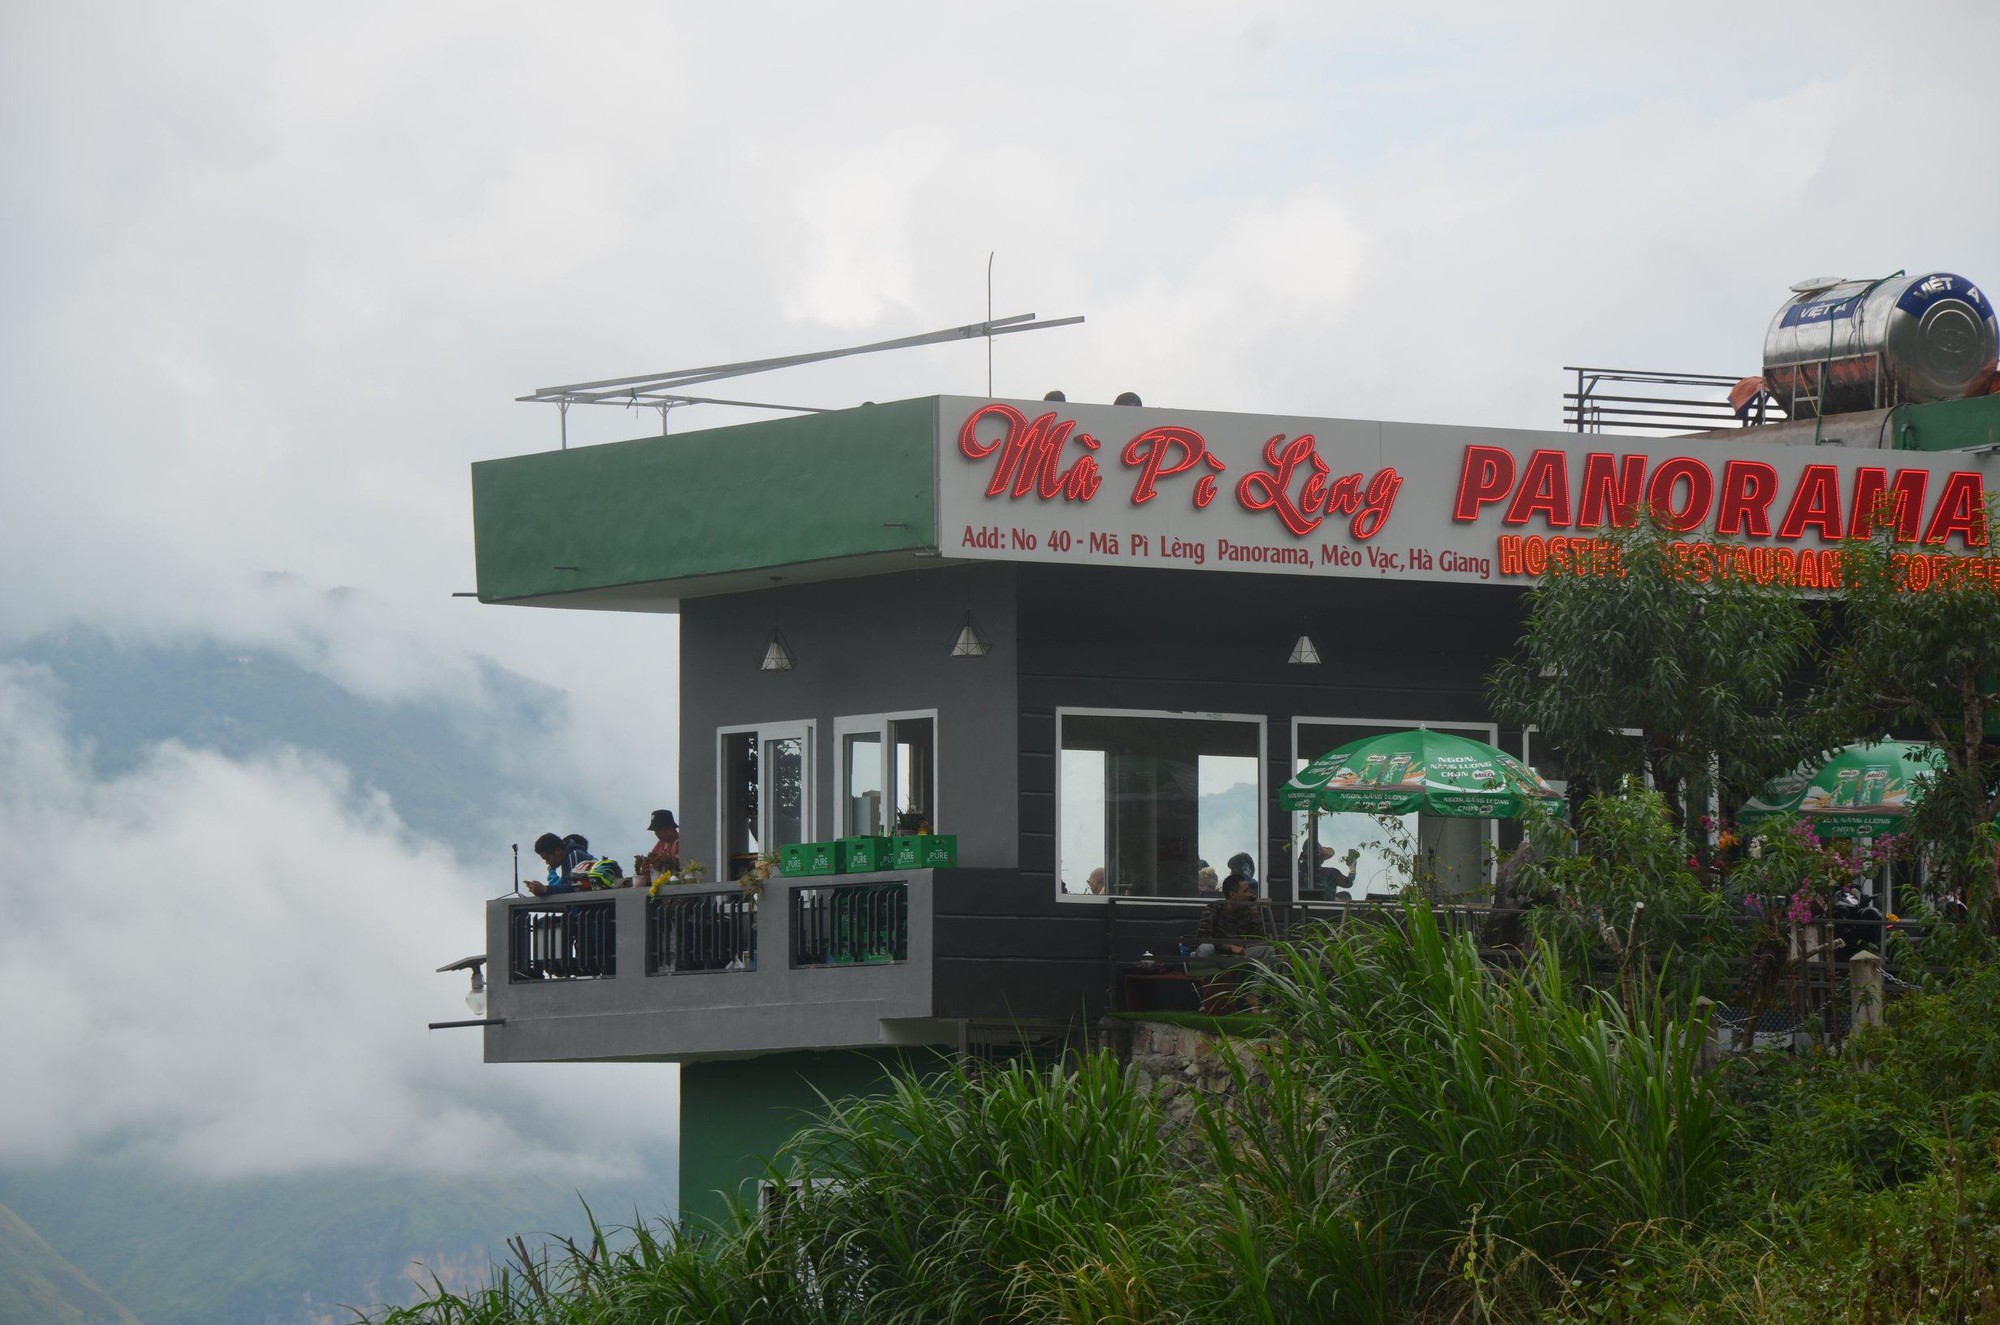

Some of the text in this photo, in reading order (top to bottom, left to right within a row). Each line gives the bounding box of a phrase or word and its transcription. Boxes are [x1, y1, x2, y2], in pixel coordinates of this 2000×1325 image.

[1121, 426, 1225, 509] Pì
[1235, 434, 1403, 541] Lèng
[1452, 444, 1989, 547] PANORAMA
[962, 525, 1006, 549] Add:
[1012, 527, 1037, 550] No
[1047, 529, 1072, 552] 40
[1090, 531, 1119, 555] Mã
[1131, 533, 1149, 556] Pì
[1161, 535, 1205, 565] Lèng
[1218, 538, 1315, 569] Panorama,
[1321, 543, 1362, 567] Mèo
[1366, 545, 1406, 574] Vạc,
[1409, 548, 1433, 571] Hà
[1439, 550, 1490, 579] Giang
[854, 855, 867, 864] PURE
[901, 851, 914, 860] PURE
[930, 852, 948, 860] PURE
[787, 859, 801, 868] PURE
[815, 857, 828, 866] PURE
